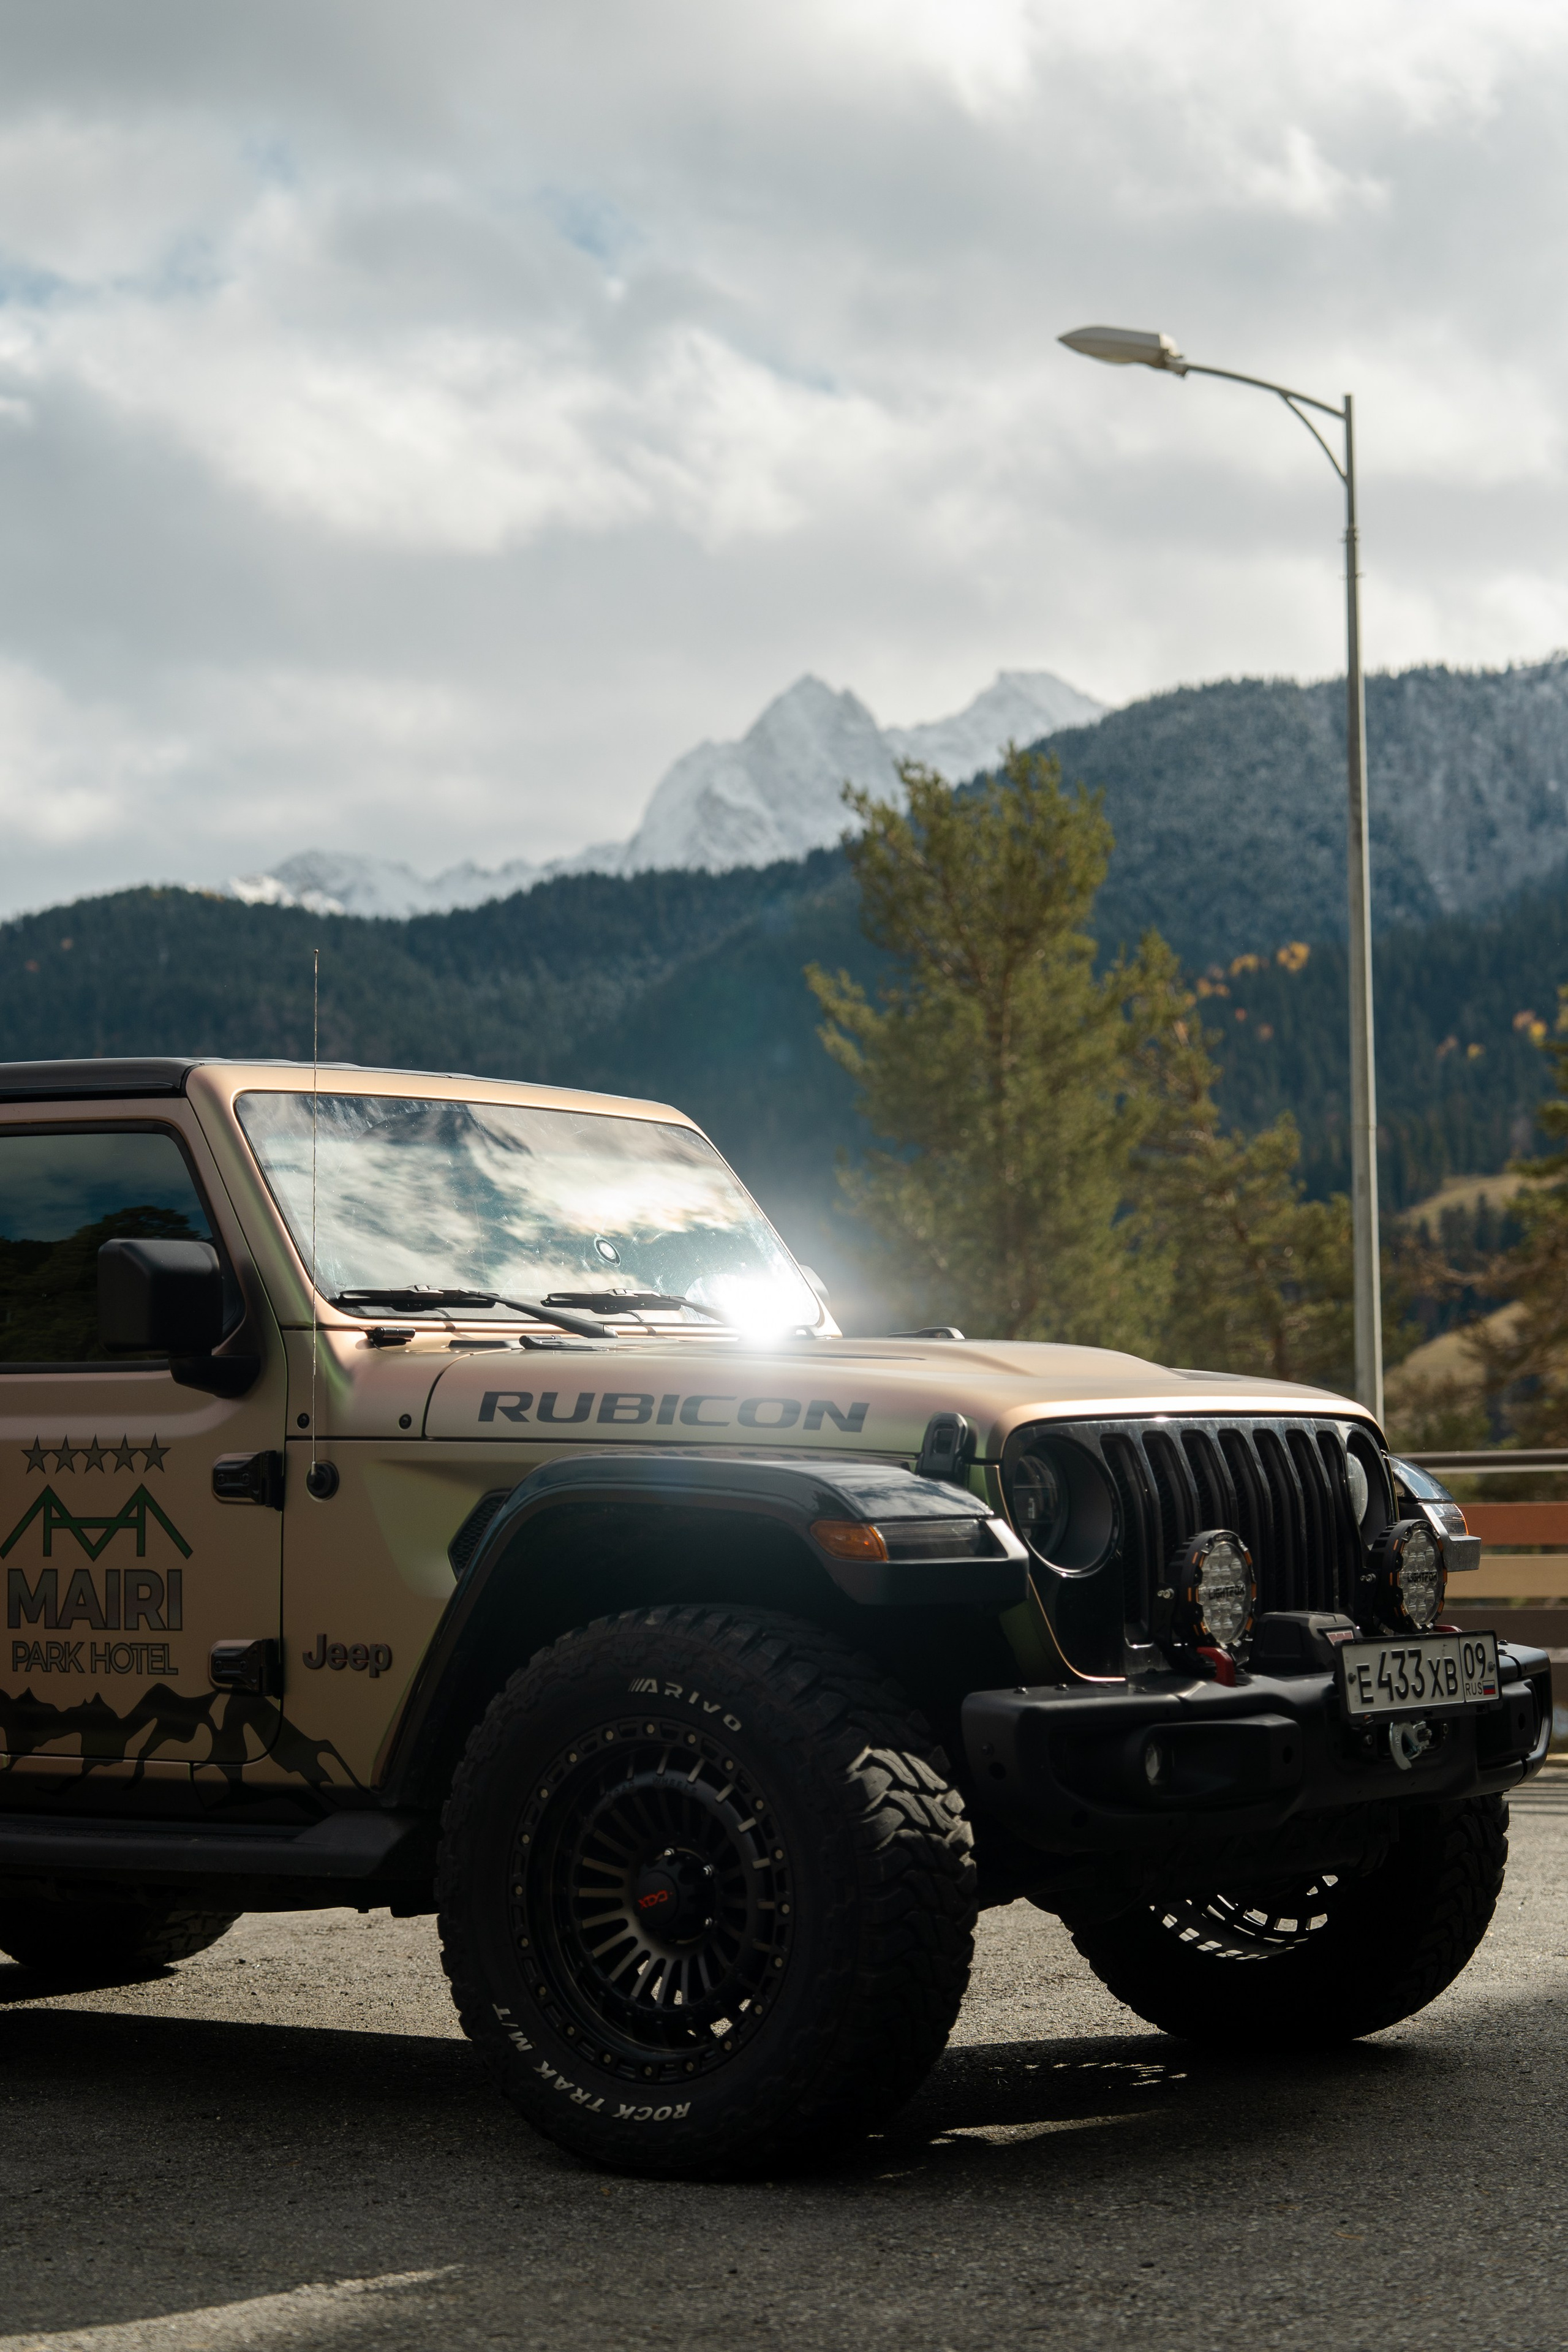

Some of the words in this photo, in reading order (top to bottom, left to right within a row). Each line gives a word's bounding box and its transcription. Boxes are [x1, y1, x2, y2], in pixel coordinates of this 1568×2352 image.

[478, 1391, 870, 1433] RUBICON
[7, 1569, 183, 1631] MAIRI
[12, 1641, 84, 1673] PARK
[91, 1642, 178, 1675] HOTEL
[303, 1634, 392, 1678] Jeep
[1464, 1642, 1487, 1679] 09
[637, 1679, 742, 1732] ARIVO
[1465, 1682, 1483, 1696] RUS
[492, 2003, 534, 2052] M/T
[532, 2060, 605, 2113] TRAK
[611, 2102, 692, 2122] ROCK
